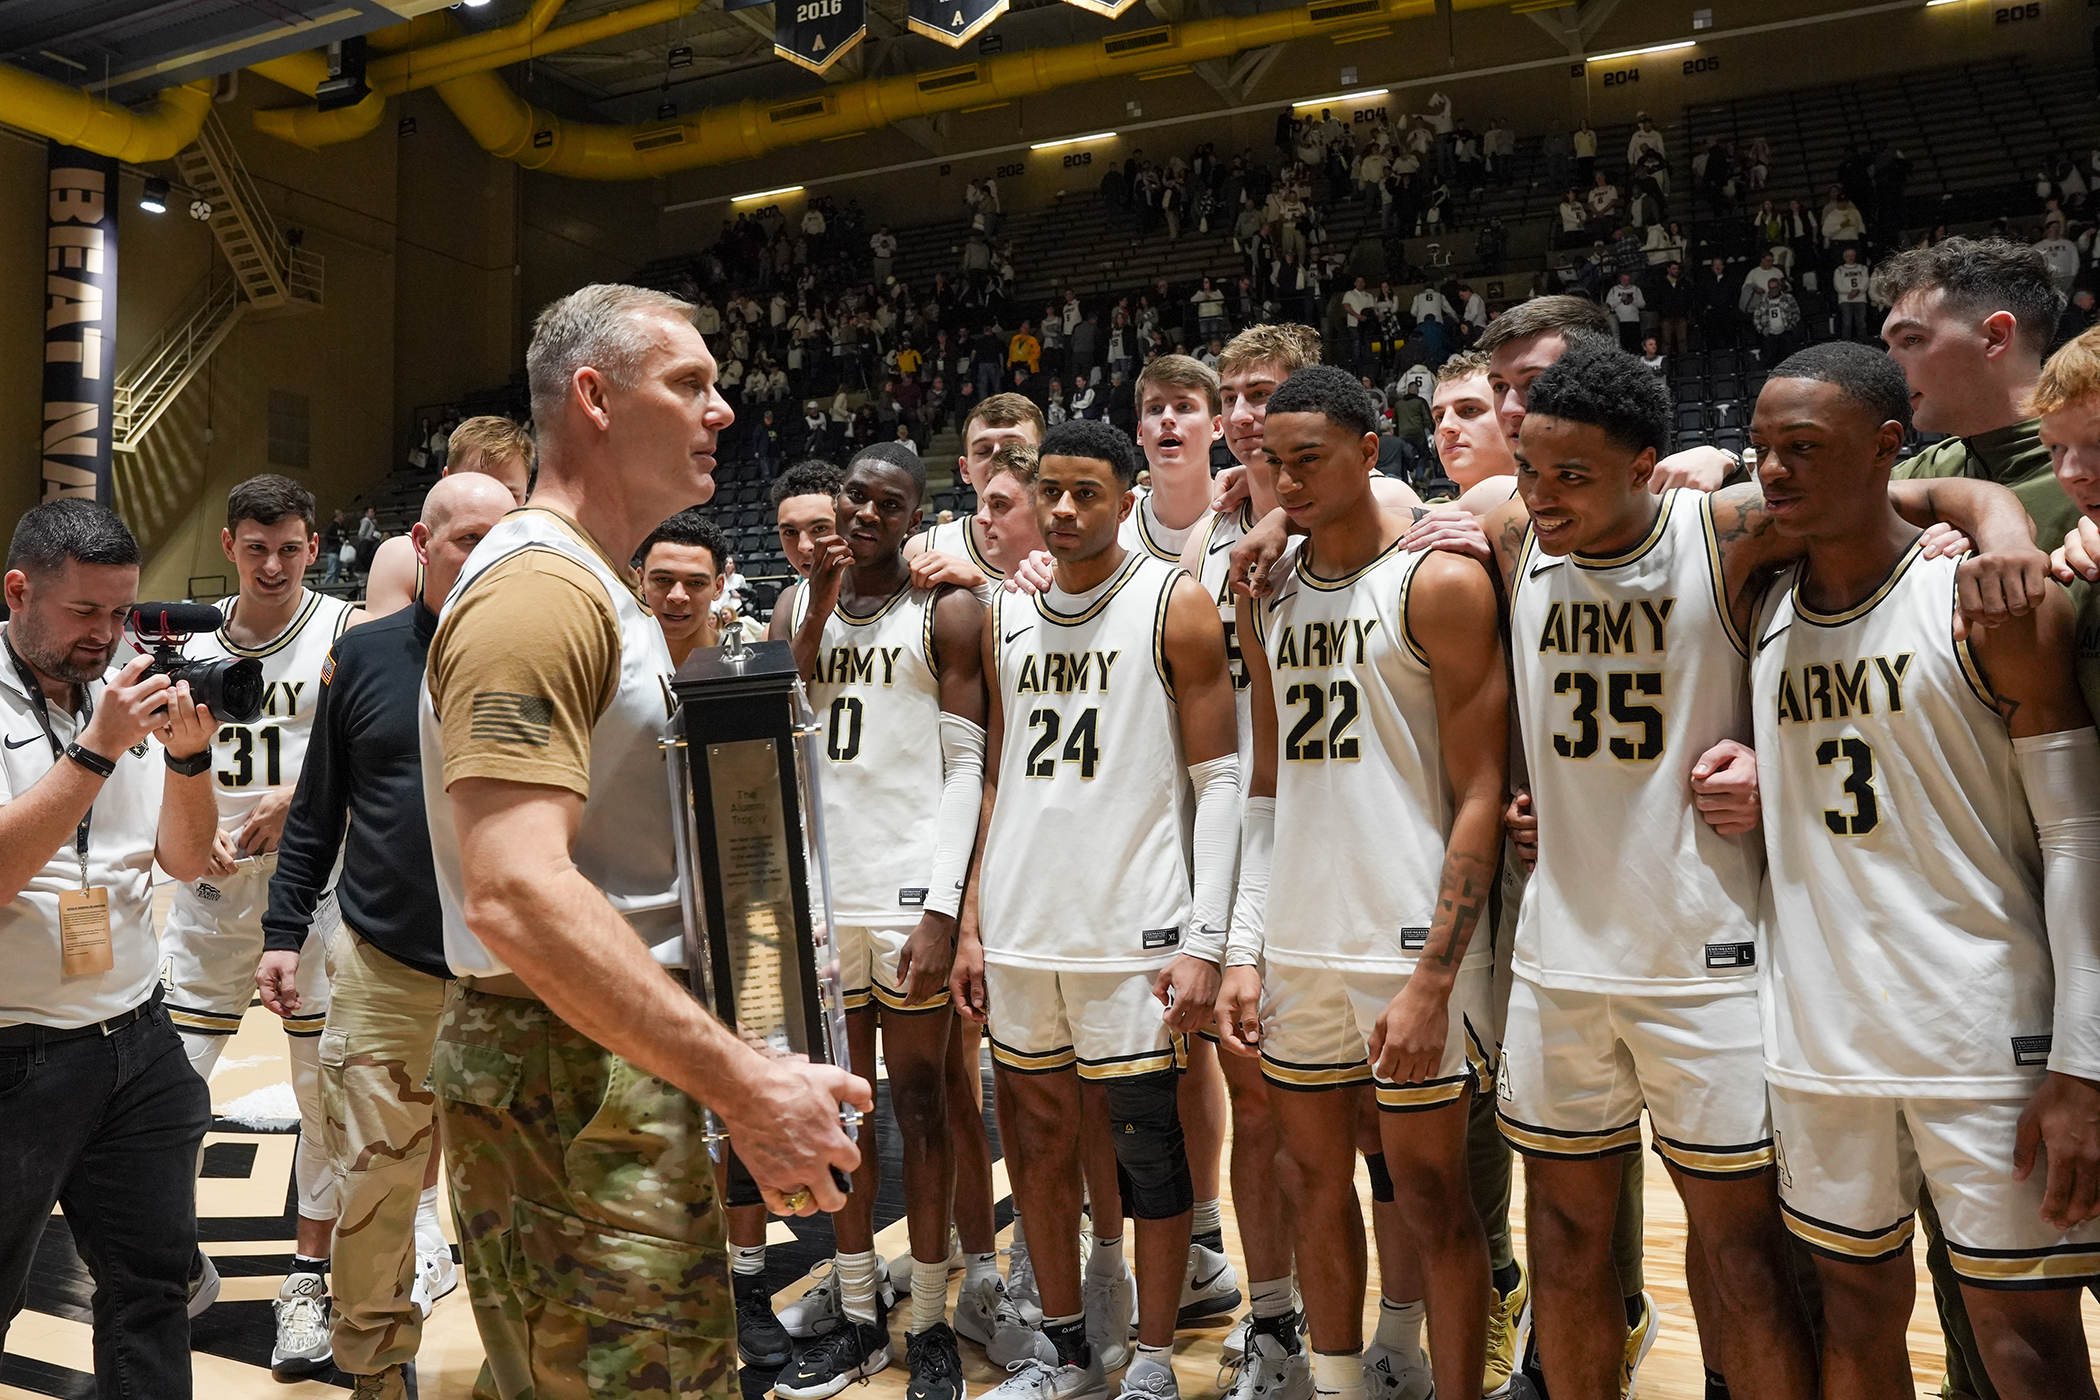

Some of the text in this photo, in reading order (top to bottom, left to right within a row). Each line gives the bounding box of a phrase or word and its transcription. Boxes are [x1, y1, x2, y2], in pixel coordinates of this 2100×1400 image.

[797, 0, 842, 22] 2016
[951, 10, 965, 26] A
[1994, 2, 2040, 24] 205
[812, 34, 826, 51] A
[1603, 68, 1640, 87] 204
[1682, 56, 1719, 76] 205
[1354, 107, 1386, 123] 204
[997, 163, 1025, 178] 202
[1063, 152, 1092, 168] 203
[1425, 293, 1433, 302] 6
[42, 166, 105, 502] BEAT NA
[1538, 597, 1677, 656] ARMY
[1277, 618, 1380, 672] ARMY
[1017, 650, 1122, 695] ARMY
[261, 681, 307, 717] MY
[1777, 652, 1916, 726] ARMY
[826, 696, 865, 763] 0
[1285, 679, 1361, 763] 22
[1553, 670, 1666, 762] 35
[217, 725, 282, 788] 31
[1025, 707, 1101, 780] 24
[1815, 736, 1882, 838] 3
[1168, 933, 1177, 941] XL
[1743, 950, 1750, 960] L
